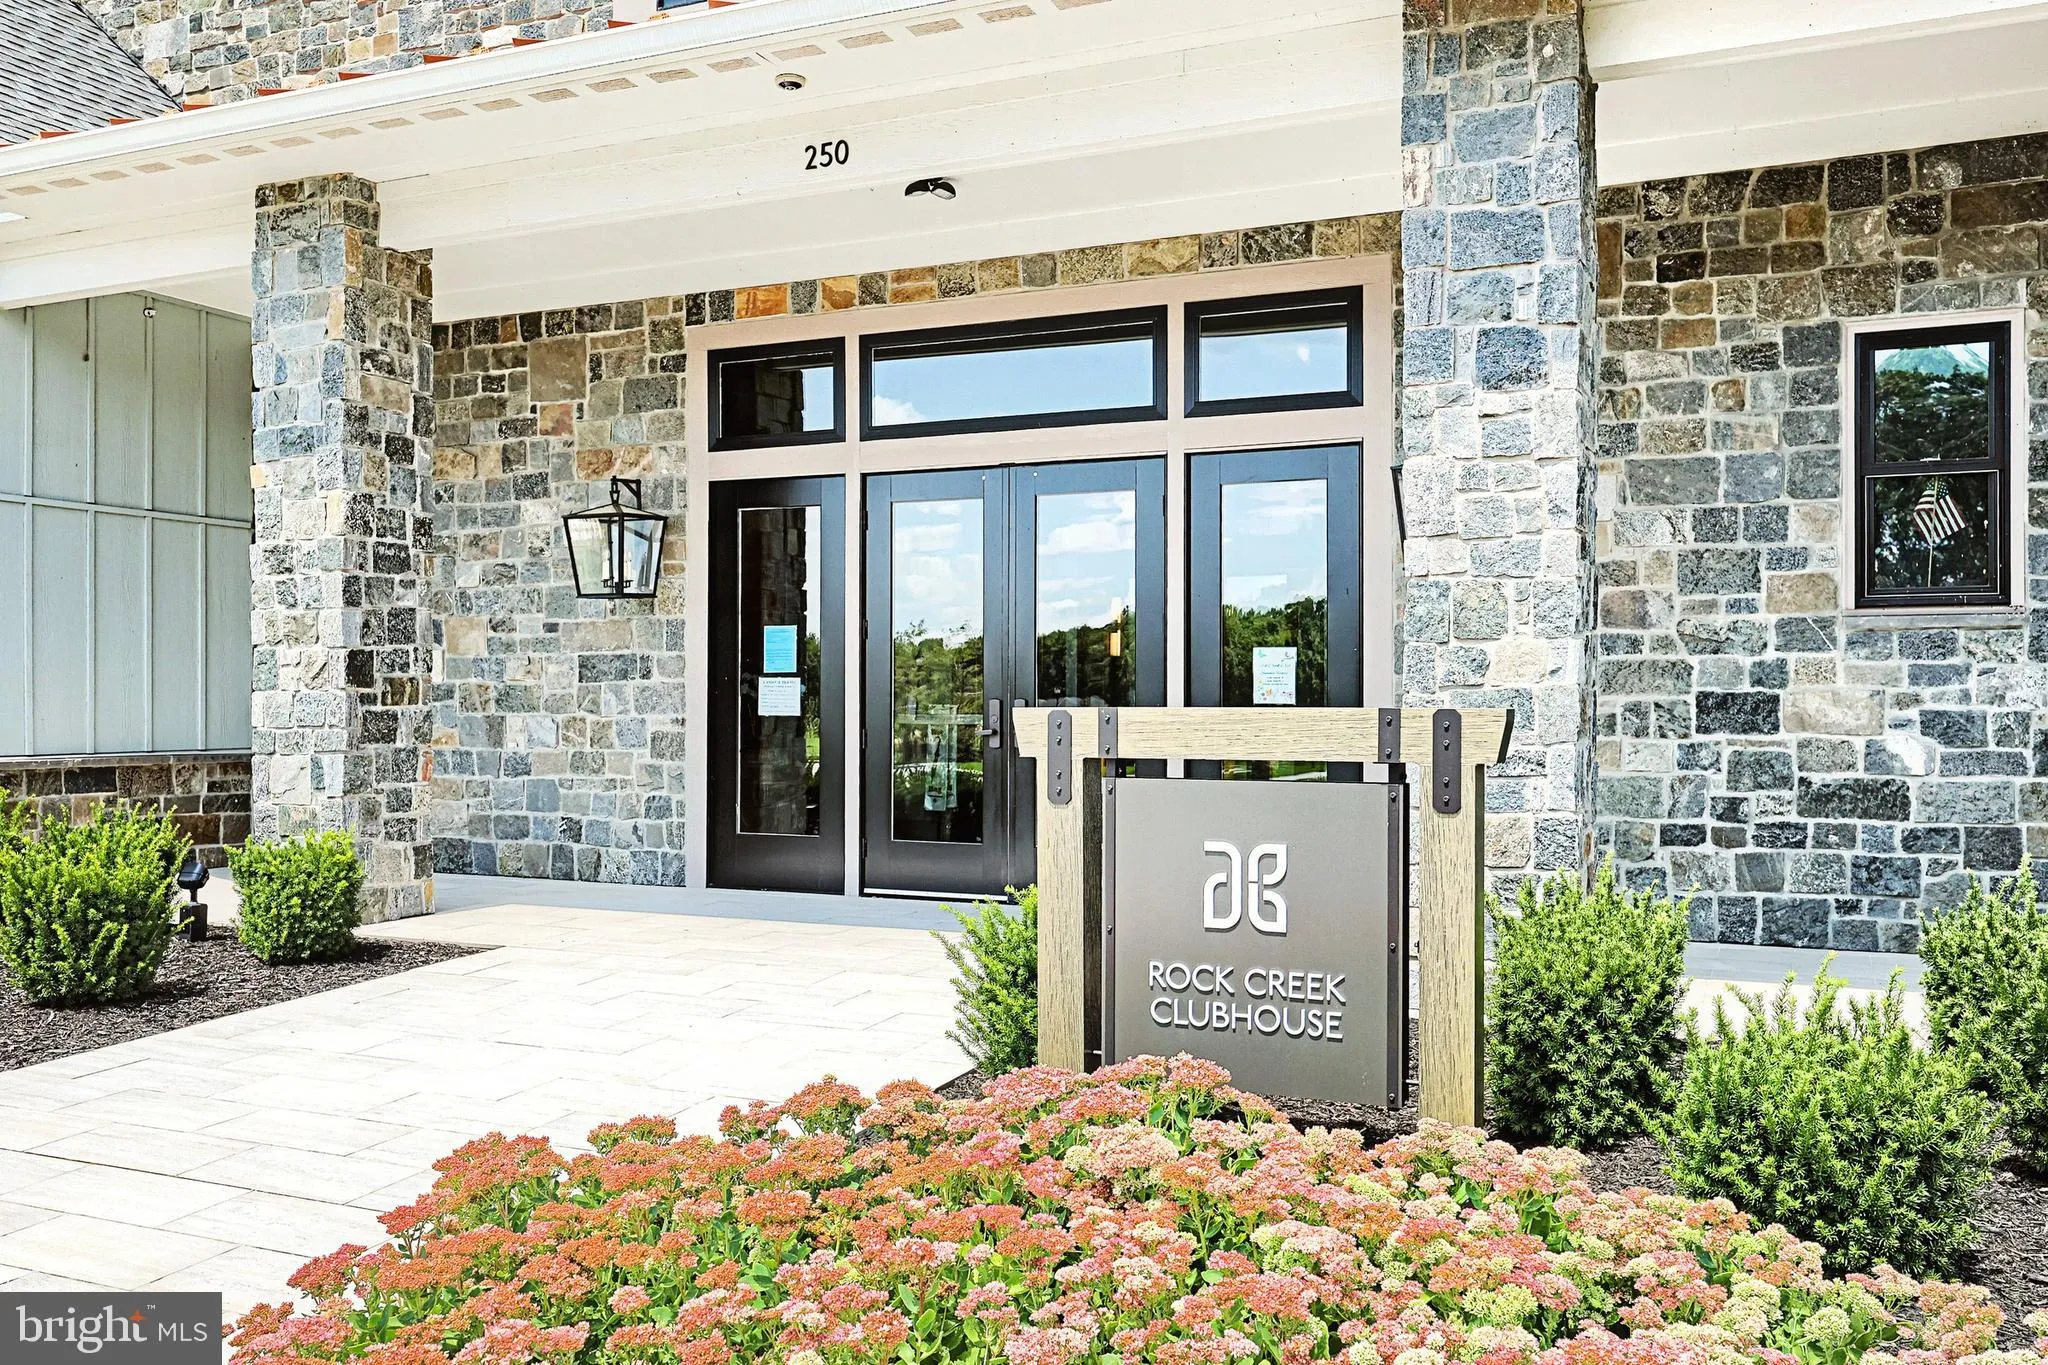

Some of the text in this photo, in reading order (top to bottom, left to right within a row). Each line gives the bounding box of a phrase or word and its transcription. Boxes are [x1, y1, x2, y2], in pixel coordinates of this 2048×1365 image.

[804, 139, 850, 170] 250
[1148, 960, 1346, 1004] ROCK CREEK
[1149, 996, 1344, 1040] CLUBHOUSE
